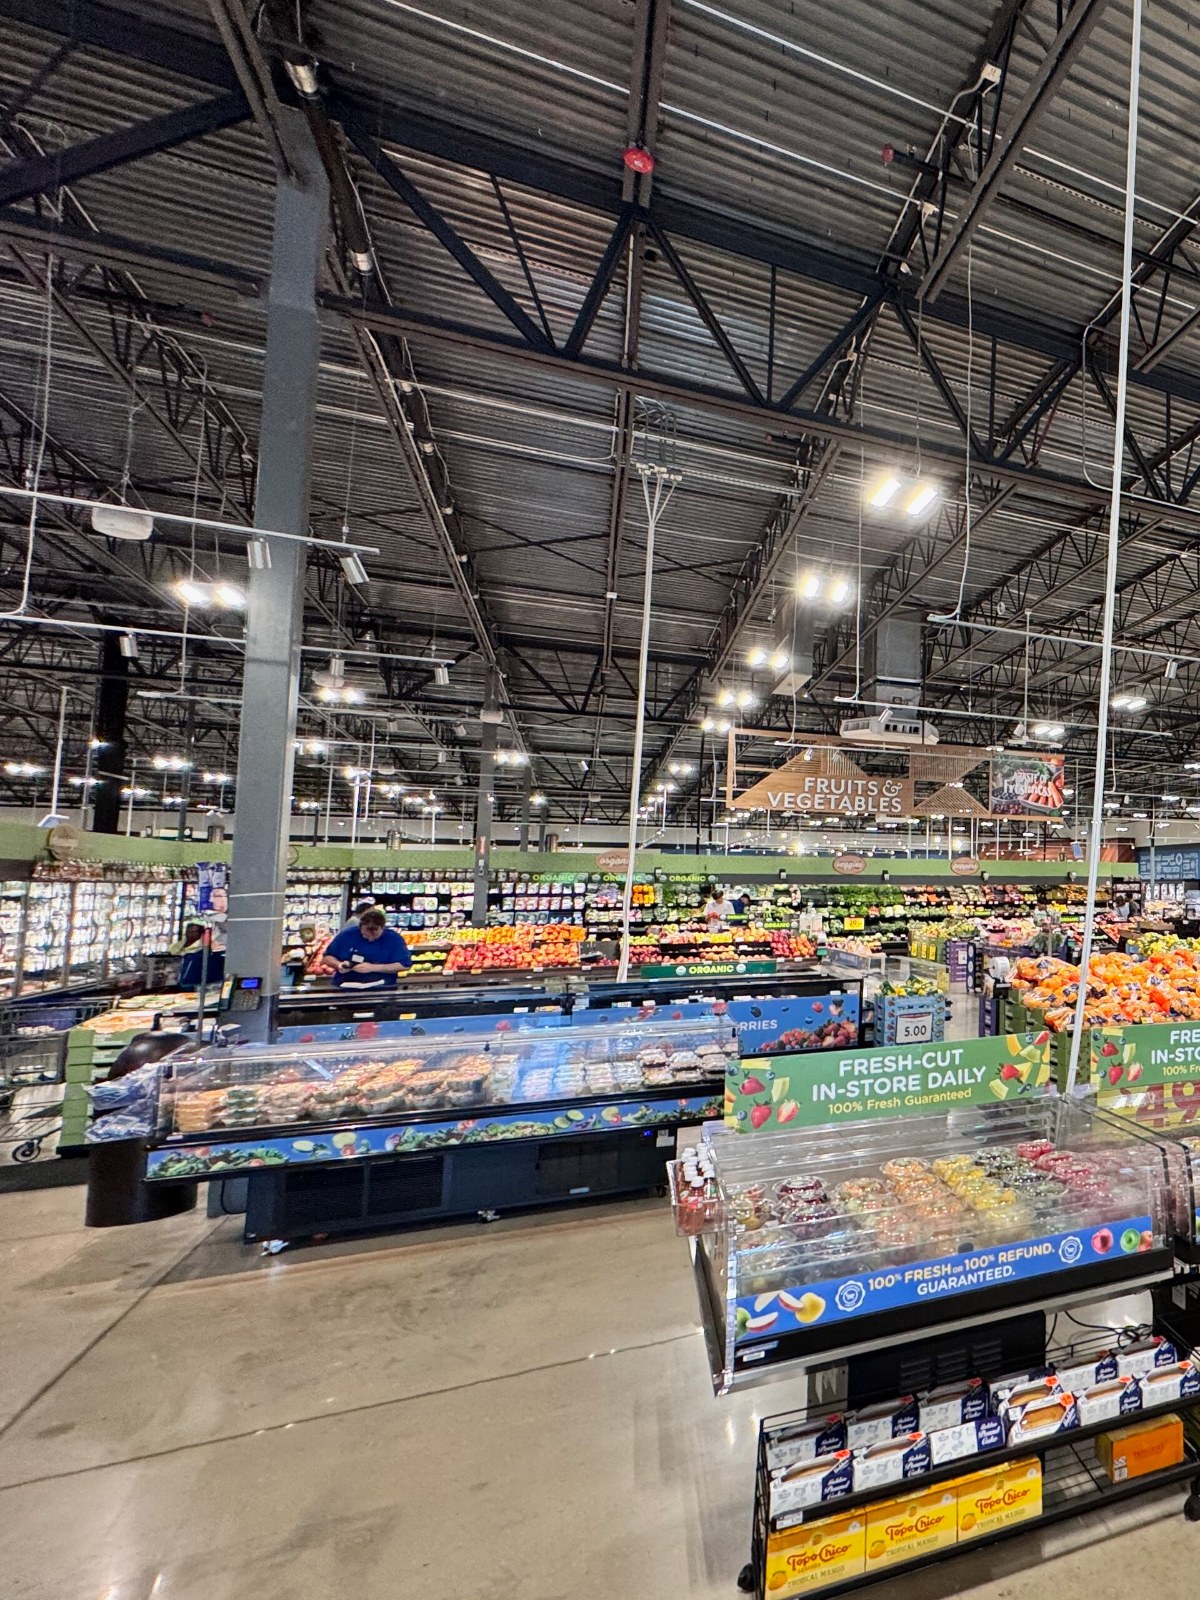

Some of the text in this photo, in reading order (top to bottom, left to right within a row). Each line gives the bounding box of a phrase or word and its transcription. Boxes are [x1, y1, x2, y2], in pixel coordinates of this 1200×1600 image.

[804, 777, 903, 797] FRUITS &
[767, 791, 902, 813] VEGETABLES
[532, 874, 576, 883] ORGANIC
[669, 874, 706, 883] ORGANIC
[688, 964, 734, 974] ORGANIC
[737, 1019, 778, 1032] RRIES
[904, 1025, 927, 1037] 5.00
[839, 1049, 963, 1077] FRESH-CUT
[1162, 1065, 1187, 1076] 100%
[812, 1066, 986, 1102] IN-STORE DAILY
[828, 1088, 972, 1115] 100% Fresh Guaranteed
[868, 1242, 1056, 1291] 100% FRESH OR 100% REFUND.
[917, 1265, 1016, 1295] GUARANTEED.
[974, 1497, 1001, 1516] Topo
[1001, 1488, 1031, 1507] Chico
[885, 1522, 914, 1543] Topo
[914, 1514, 945, 1534] Chico
[787, 1551, 818, 1571] Topo
[819, 1543, 852, 1562] Chico
